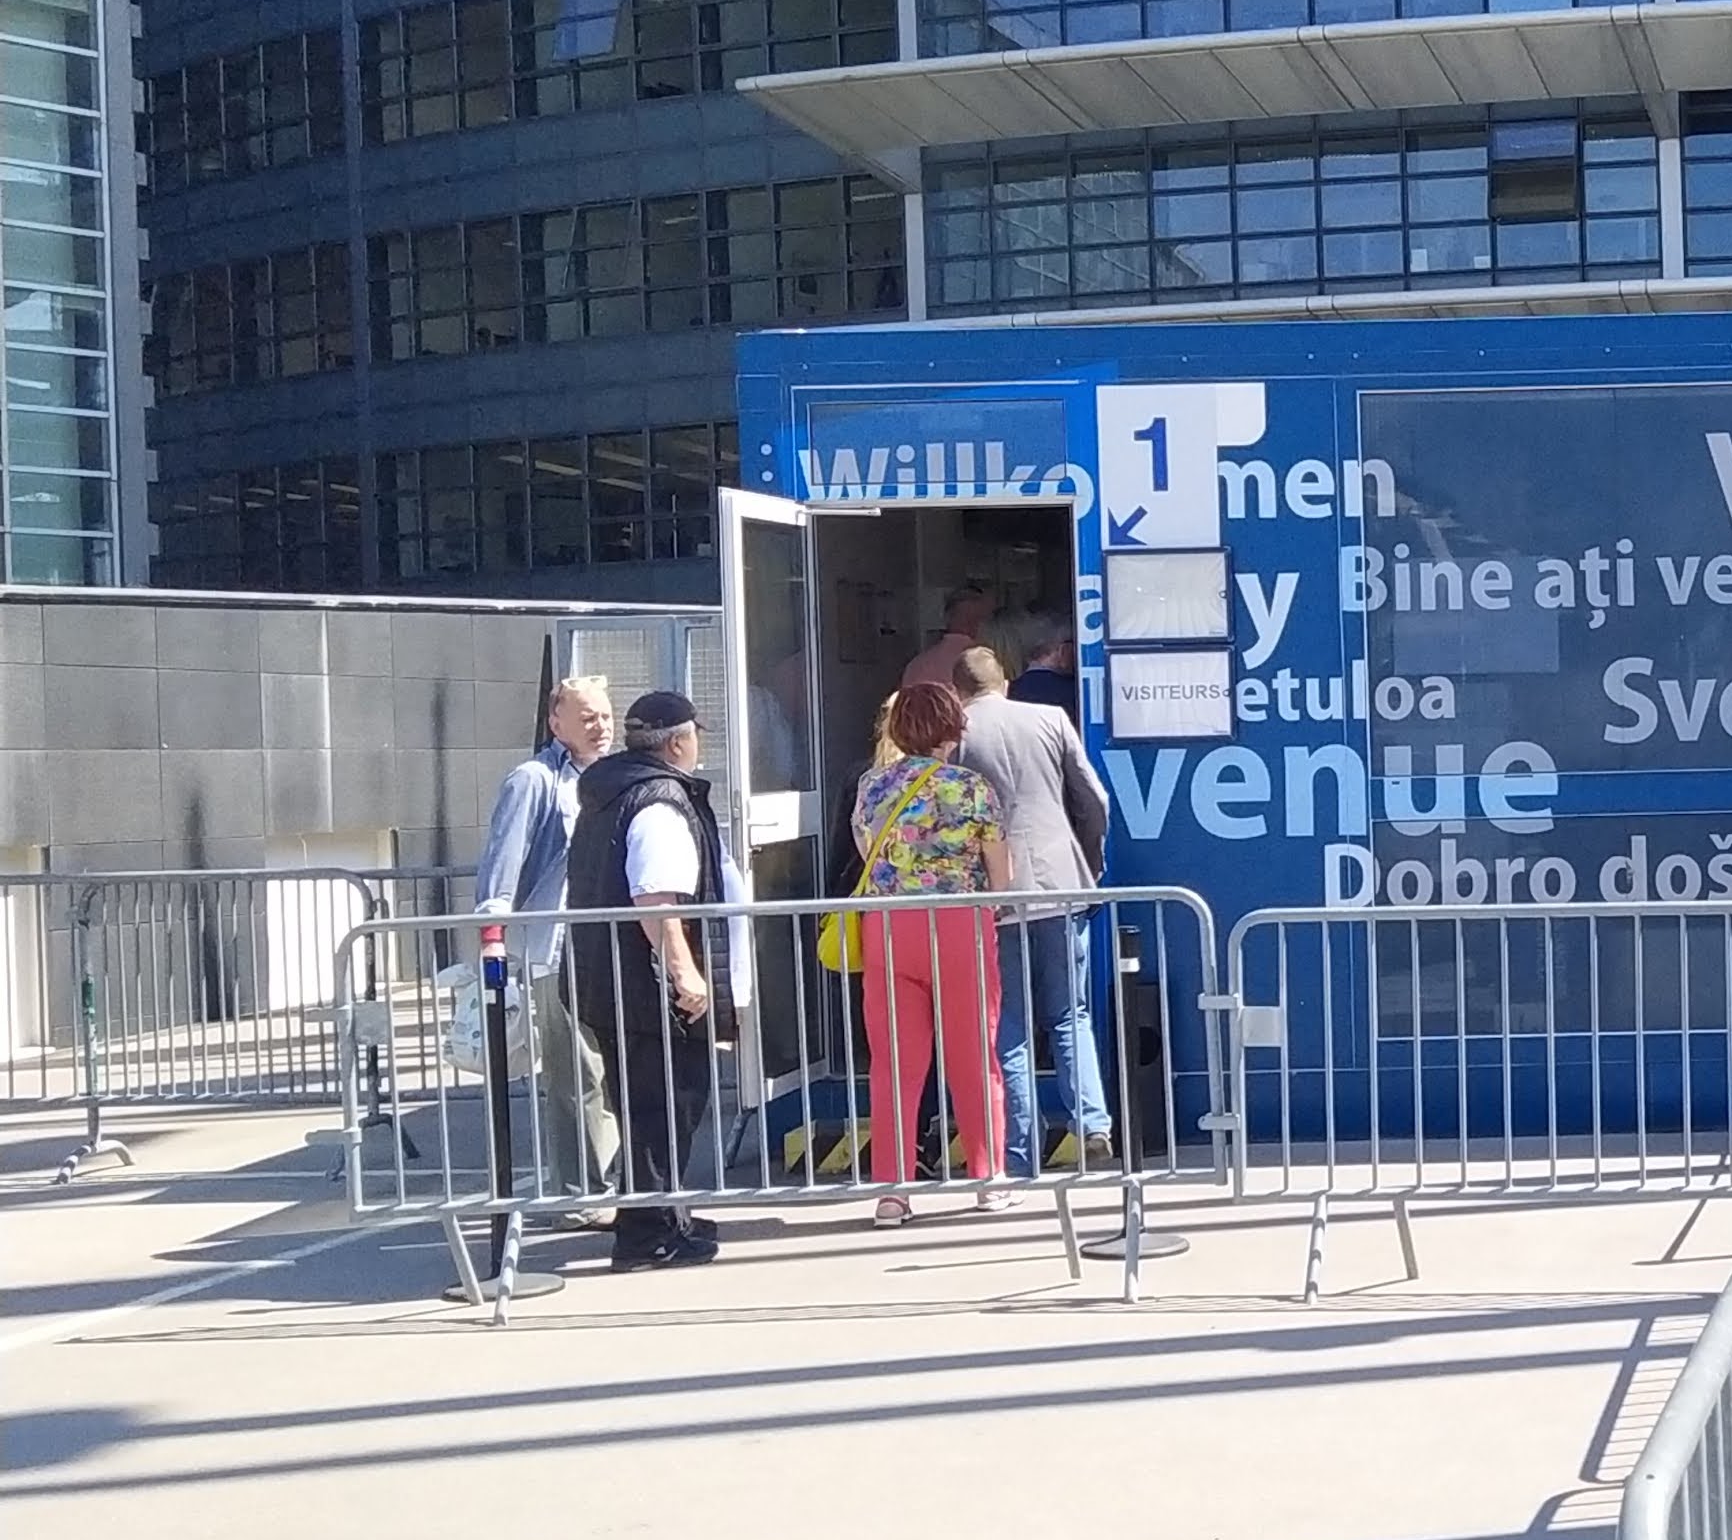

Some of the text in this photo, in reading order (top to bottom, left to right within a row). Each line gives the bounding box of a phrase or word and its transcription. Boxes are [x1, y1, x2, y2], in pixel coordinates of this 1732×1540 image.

[797, 440, 1396, 520] Willkomen
[1134, 417, 1169, 493] 1
[1340, 542, 1514, 612] Bine
[1121, 683, 1221, 702] VISITEURS
[1323, 838, 1577, 907] Dobro
